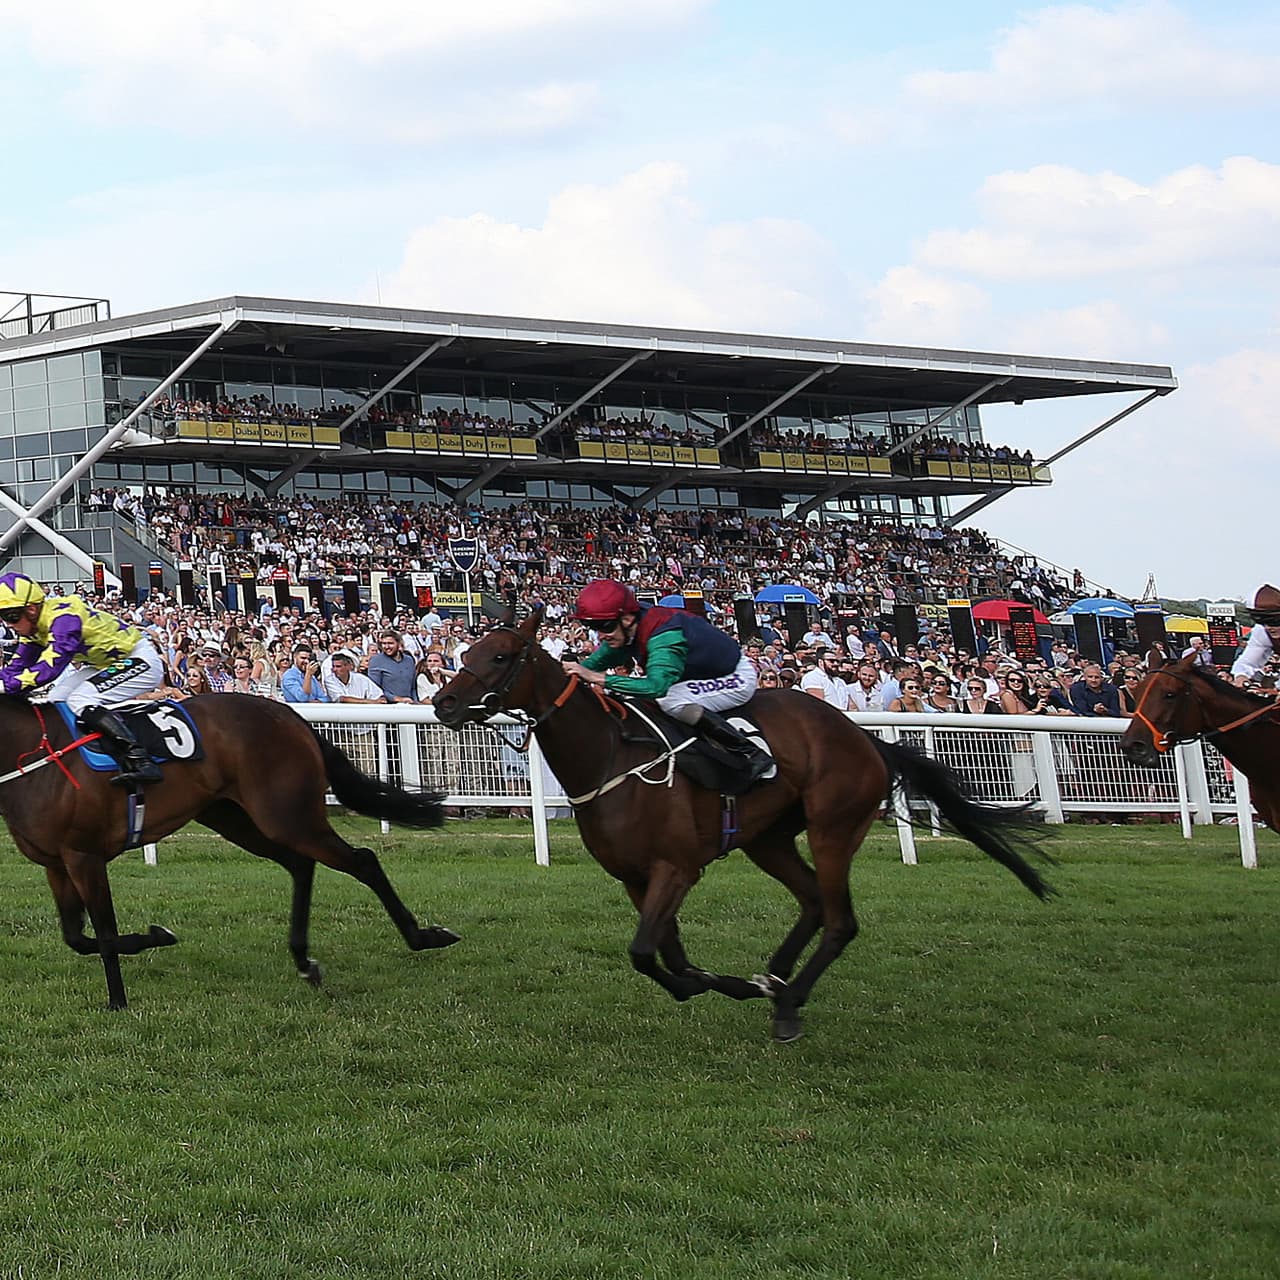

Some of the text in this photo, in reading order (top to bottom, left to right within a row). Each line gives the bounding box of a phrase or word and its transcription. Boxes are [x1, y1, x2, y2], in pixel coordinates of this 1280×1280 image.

[264, 428, 283, 438] Duty
[291, 429, 308, 438] Free
[465, 439, 484, 449] Duty
[491, 440, 506, 449] Free
[687, 673, 745, 695] Stobart
[147, 705, 196, 759] 5
